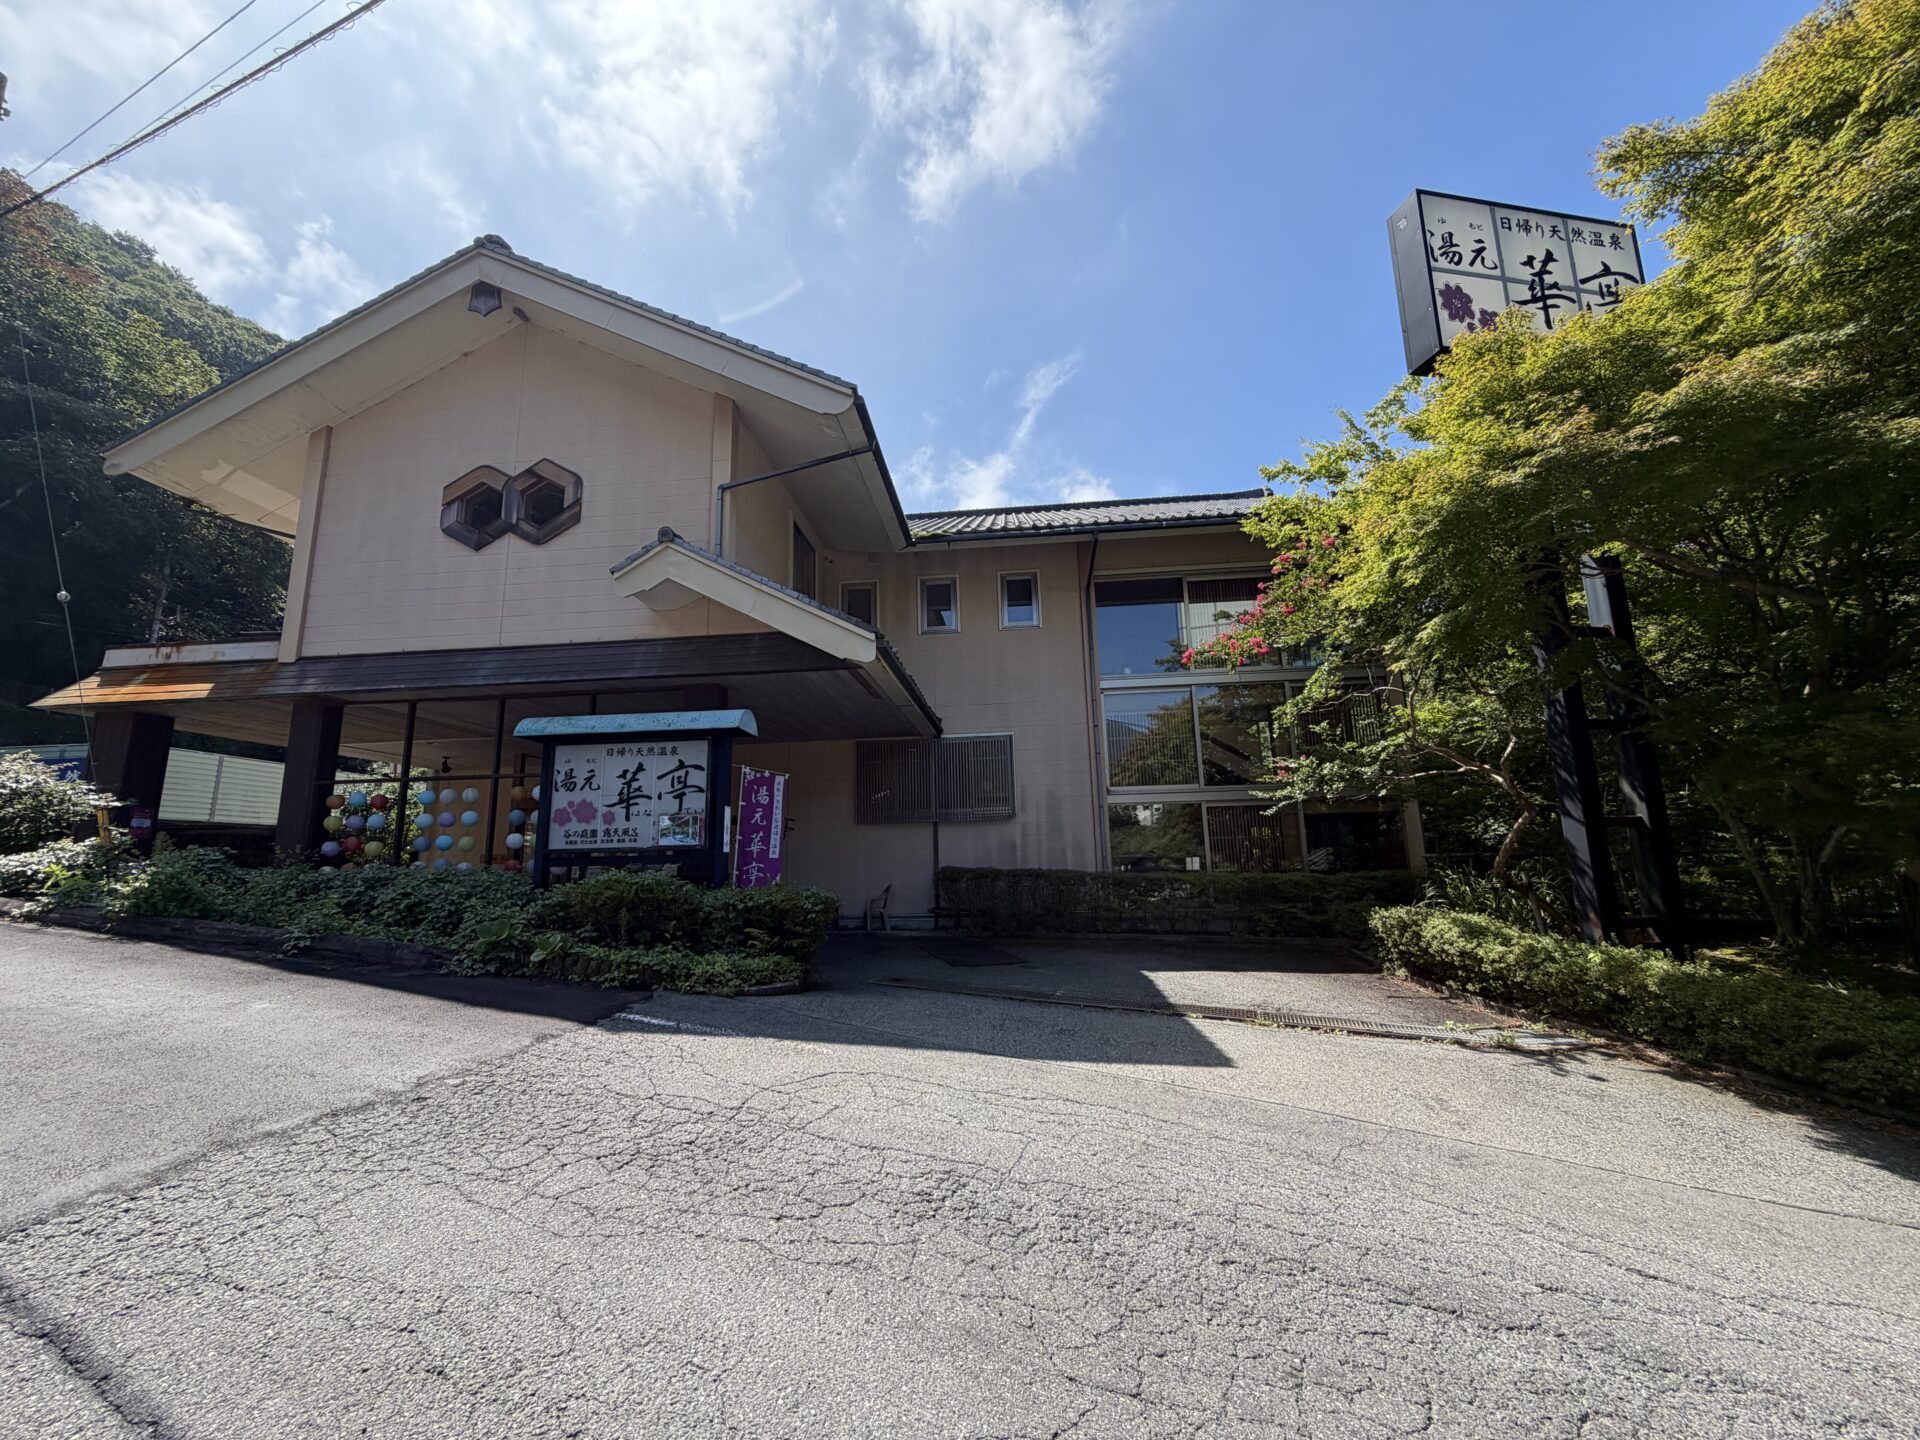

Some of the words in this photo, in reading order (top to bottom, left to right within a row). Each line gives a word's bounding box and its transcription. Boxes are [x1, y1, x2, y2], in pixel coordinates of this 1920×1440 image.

[1468, 222, 1484, 231] もと
[1500, 216, 1625, 251] 日帰り天然温泉
[1427, 229, 1499, 270] 湯元
[606, 746, 679, 757] 日帰り天然温泉
[553, 768, 601, 793] 湯元
[603, 758, 706, 822] 華亭
[602, 826, 639, 838] 露天風呂
